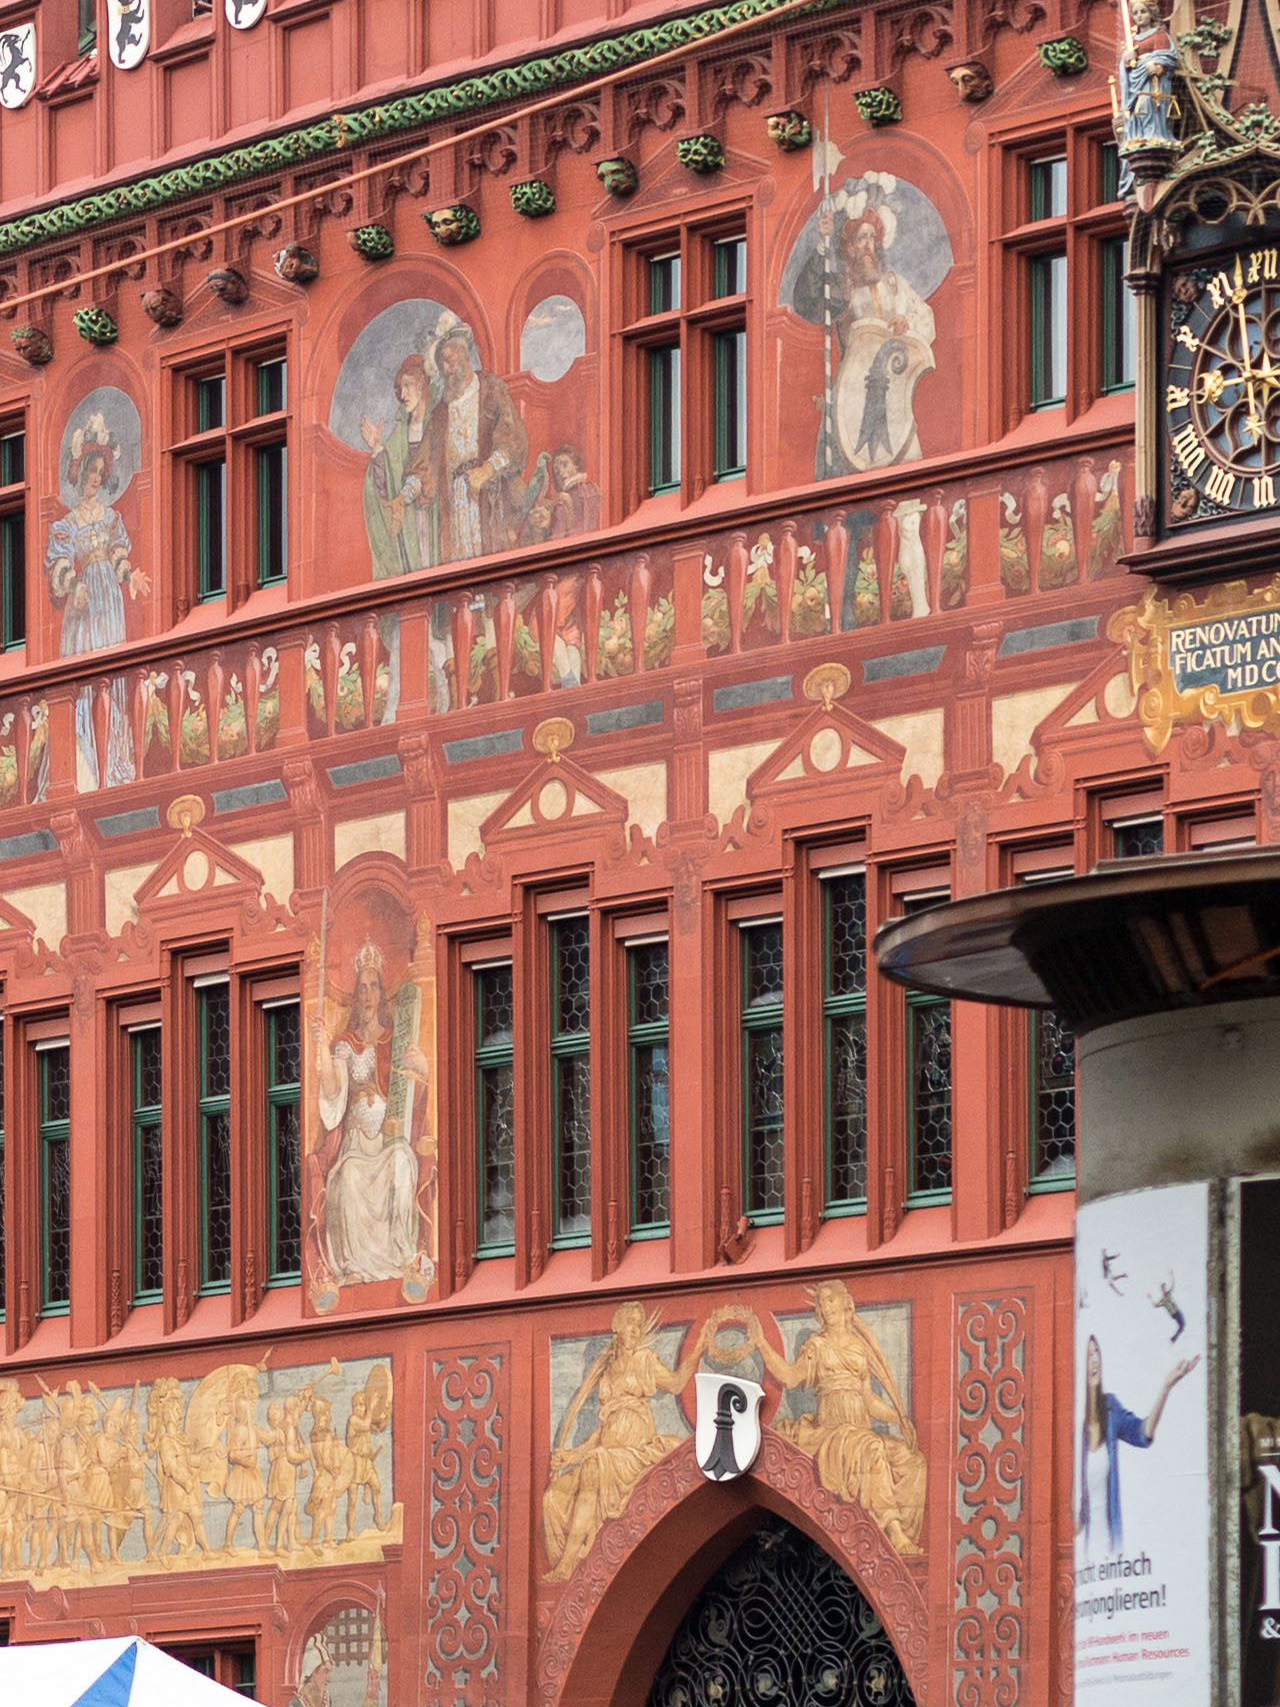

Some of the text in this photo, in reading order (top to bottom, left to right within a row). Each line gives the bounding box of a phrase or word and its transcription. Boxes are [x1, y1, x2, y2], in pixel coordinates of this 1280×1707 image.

[1175, 641, 1252, 675] FICATUM
[1099, 1551, 1151, 1581] einfach
[1141, 1630, 1169, 1641] neuen
[1141, 1648, 1190, 1661] Resources
